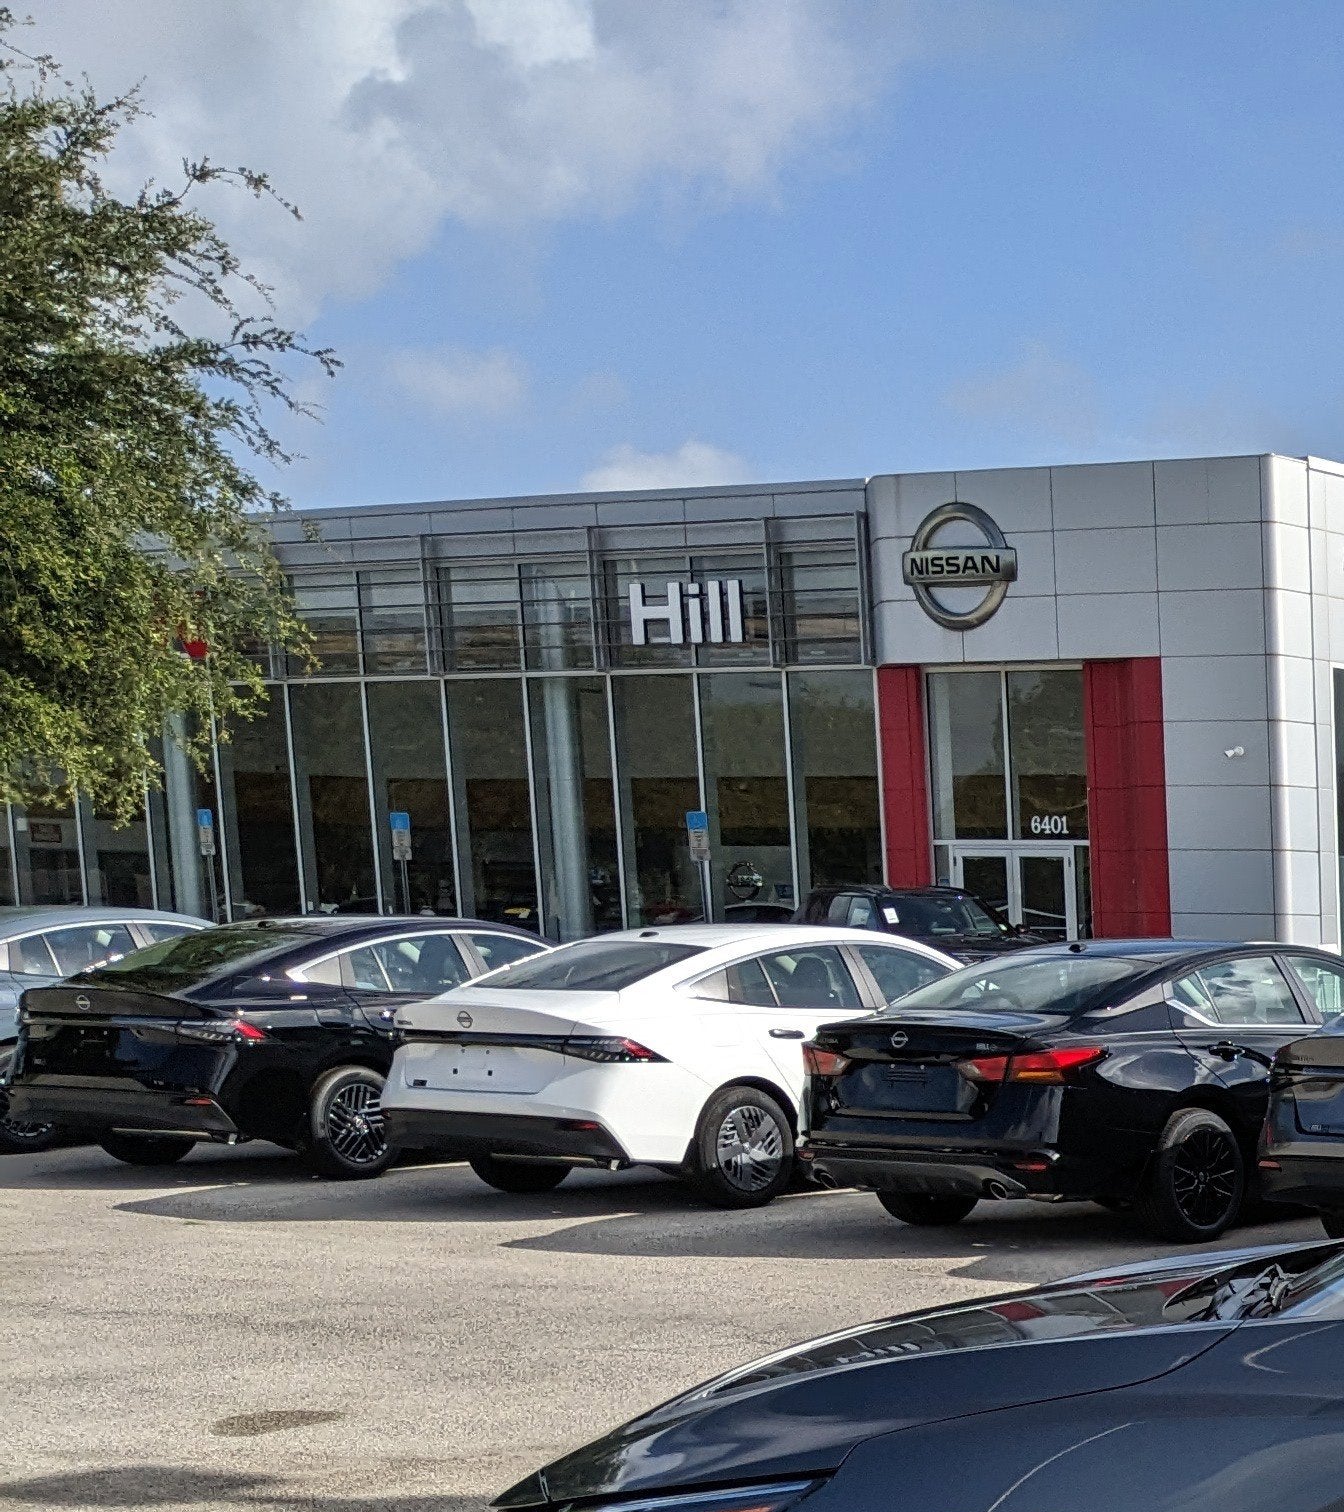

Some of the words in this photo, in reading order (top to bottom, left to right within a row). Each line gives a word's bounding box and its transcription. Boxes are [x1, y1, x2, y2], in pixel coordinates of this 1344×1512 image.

[910, 554, 1001, 576] NISSAN
[629, 579, 744, 645] Hill
[1031, 815, 1069, 834] 6401
